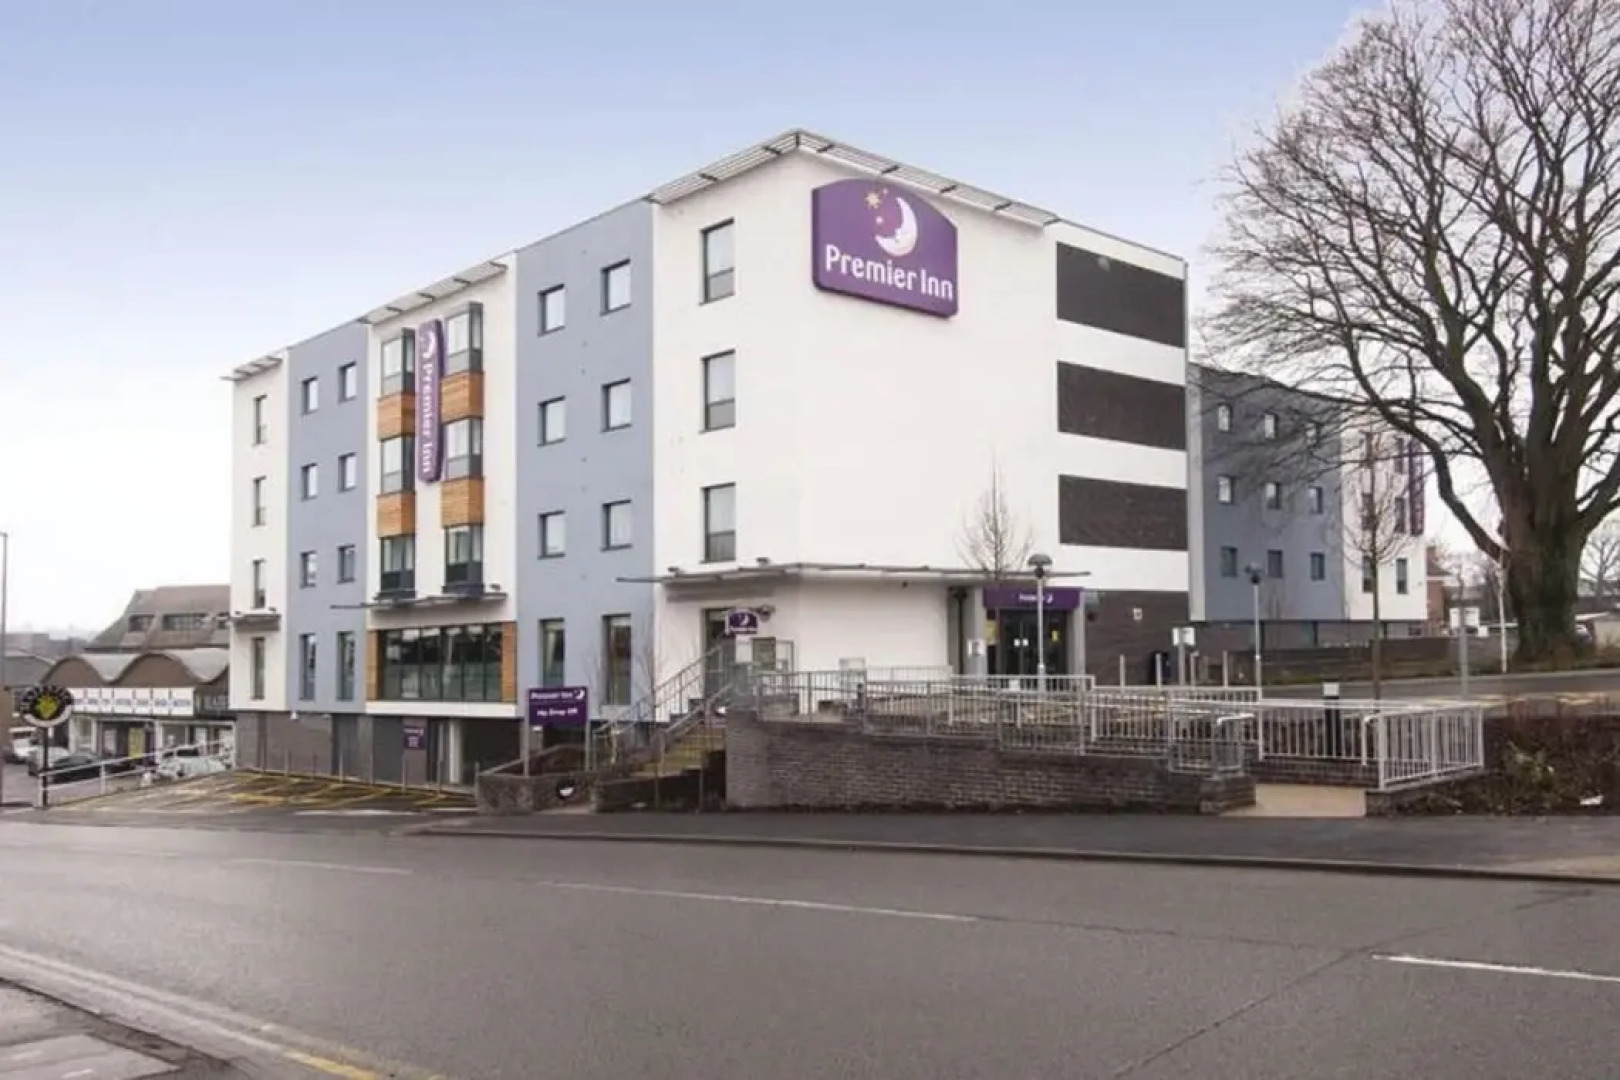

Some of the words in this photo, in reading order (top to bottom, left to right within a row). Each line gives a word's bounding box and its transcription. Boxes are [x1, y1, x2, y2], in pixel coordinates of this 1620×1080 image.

[825, 244, 917, 290] Premier
[920, 268, 954, 300] Inn
[422, 363, 433, 436] Premier
